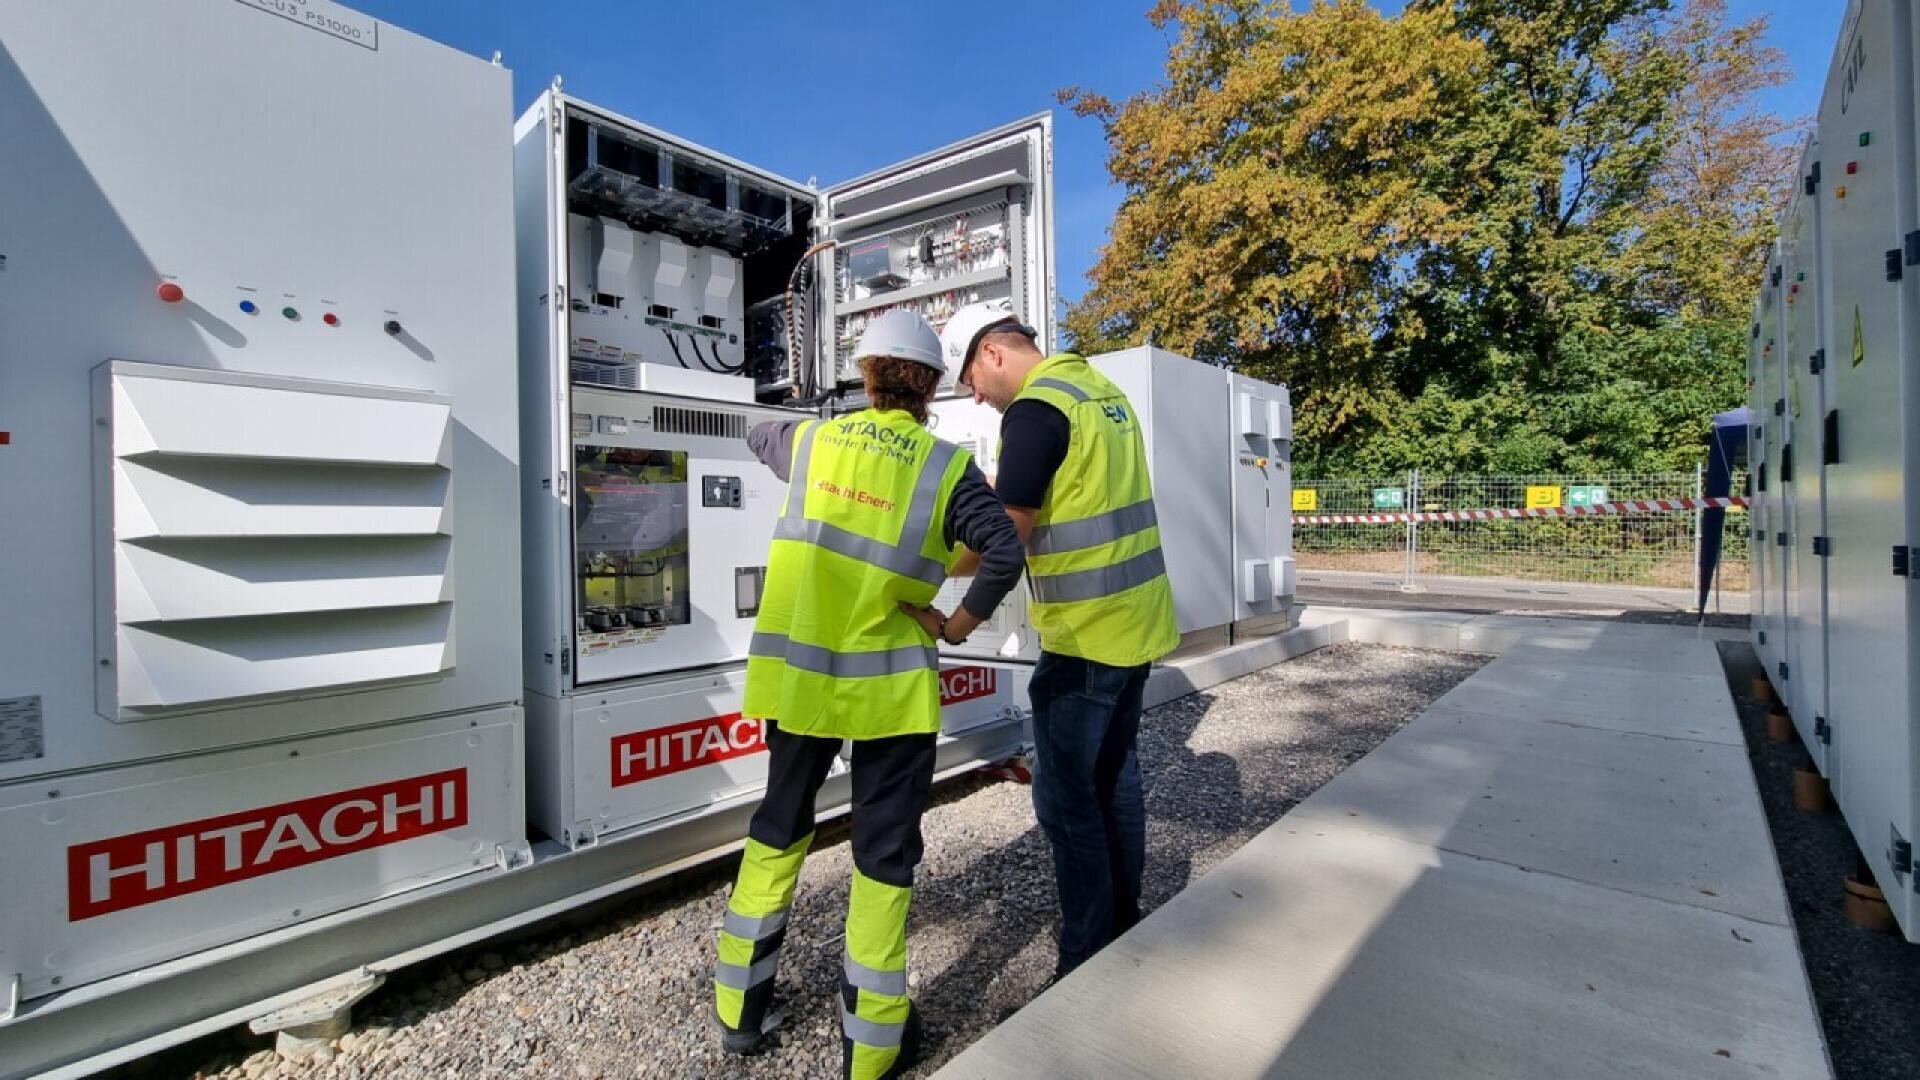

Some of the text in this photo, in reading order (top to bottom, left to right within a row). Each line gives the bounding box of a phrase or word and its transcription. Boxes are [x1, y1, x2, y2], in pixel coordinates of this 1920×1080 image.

[305, 11, 361, 39] PS1000
[620, 717, 768, 777] HITAC
[89, 780, 456, 904] HITACHI
